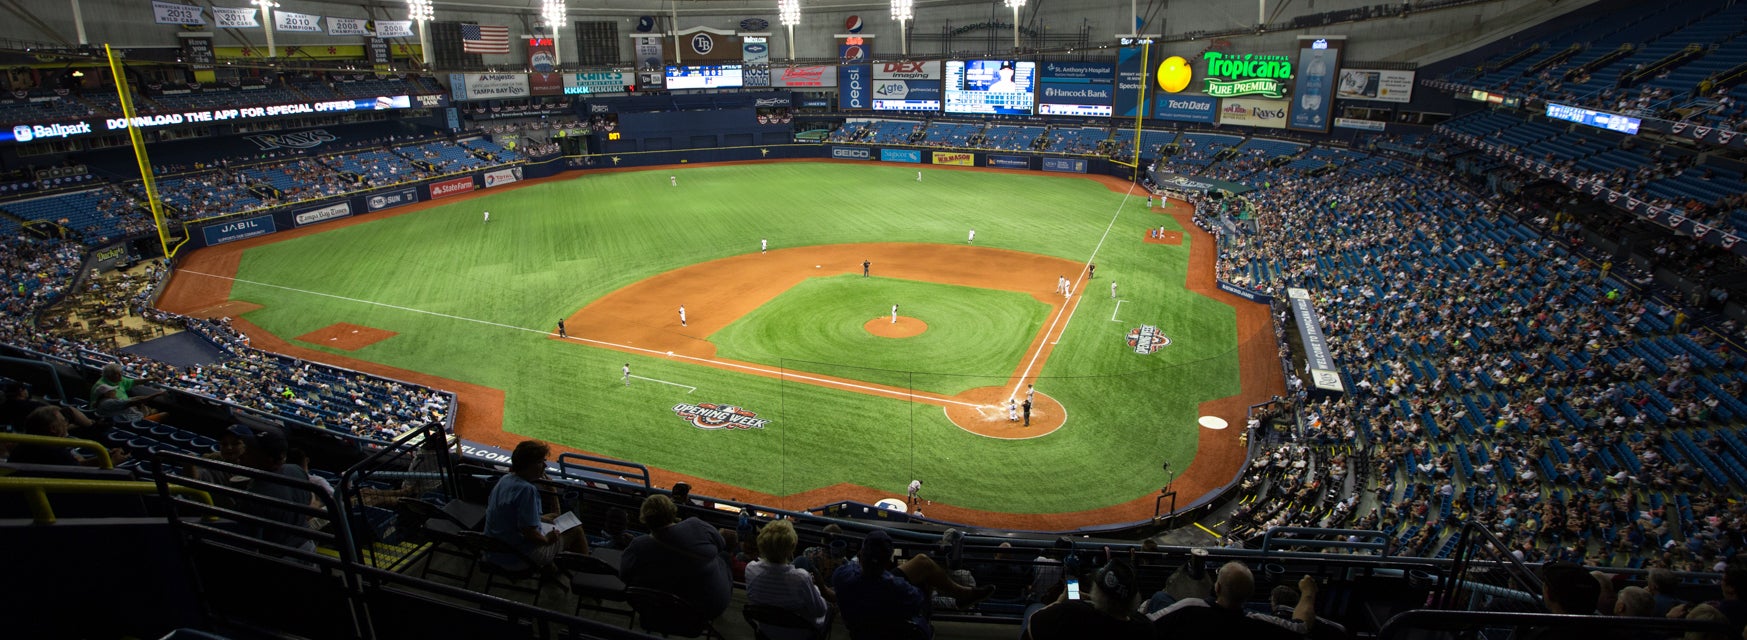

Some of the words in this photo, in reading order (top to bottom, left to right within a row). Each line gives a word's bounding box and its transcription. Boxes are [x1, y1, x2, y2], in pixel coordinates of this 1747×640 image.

[167, 10, 192, 18] 2013
[286, 18, 310, 26] 2010
[883, 60, 926, 73] DEX
[1204, 52, 1292, 80] Tropicana
[848, 68, 862, 108] pepsi
[887, 84, 903, 93] gte
[1054, 88, 1086, 97] Hancock
[1208, 82, 1232, 95] PURE
[1234, 82, 1276, 93] PREMIUM
[106, 113, 183, 130] DOWNLOAD
[184, 111, 213, 123] THE
[214, 109, 240, 120] APP
[240, 106, 266, 118] FOR
[266, 104, 314, 116] SPECIAL
[315, 100, 356, 112] OFFERS
[1276, 108, 1285, 118] 6
[33, 121, 91, 139] Ballpark
[834, 149, 868, 158] GEICO
[387, 195, 400, 204] SUN
[299, 214, 318, 222] Tampa
[221, 221, 258, 232] JABIL
[1301, 310, 1317, 335] TROPICANA
[1312, 342, 1328, 369] WELCOME
[672, 403, 730, 420] OPENING
[730, 414, 767, 428] WEEK
